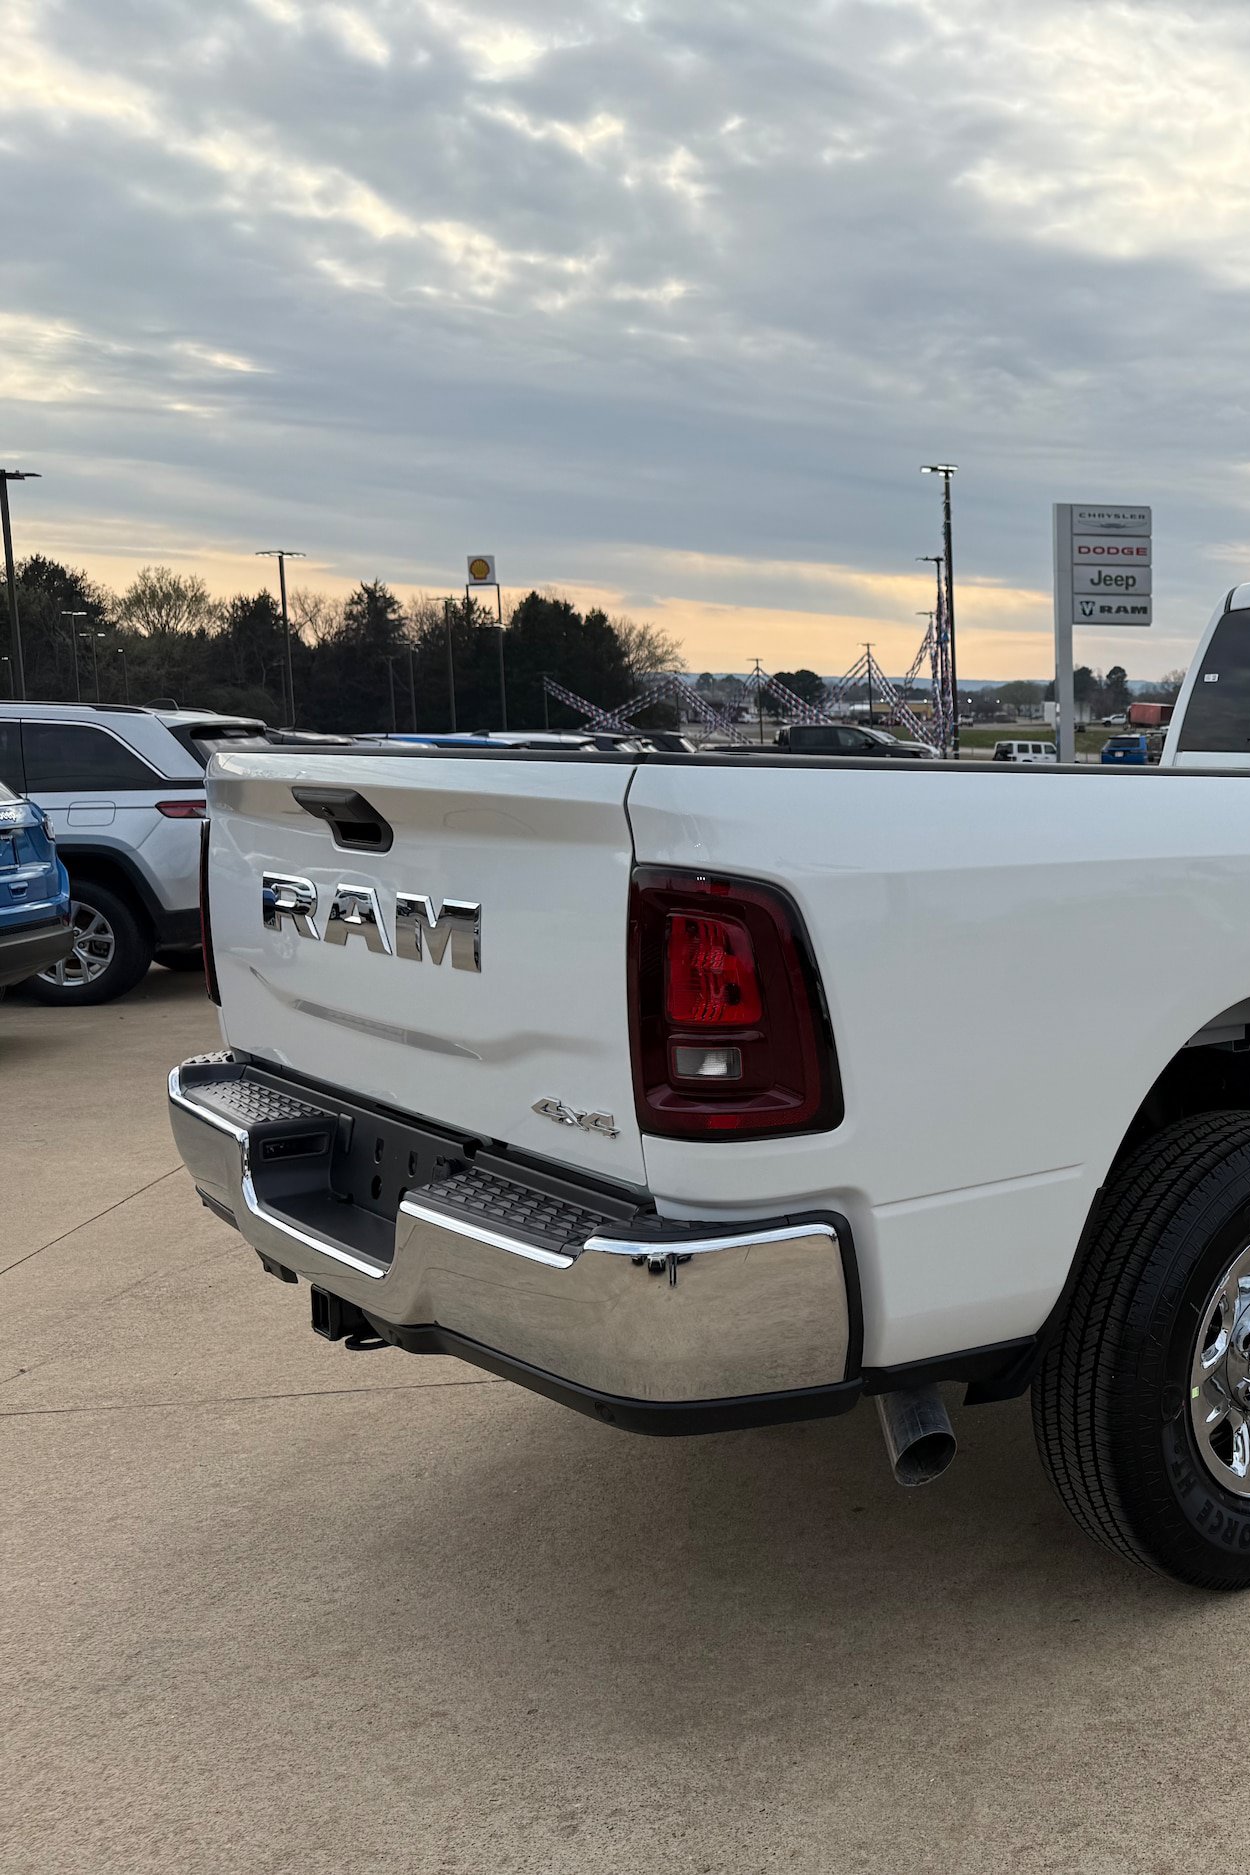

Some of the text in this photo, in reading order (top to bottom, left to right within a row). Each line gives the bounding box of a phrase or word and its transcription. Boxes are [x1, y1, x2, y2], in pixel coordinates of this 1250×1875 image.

[1079, 512, 1146, 520] CHRYSLER
[1077, 546, 1148, 556] DODGE
[1090, 570, 1137, 590] Jeep
[1099, 605, 1148, 615] RAM
[262, 871, 482, 973] RAM
